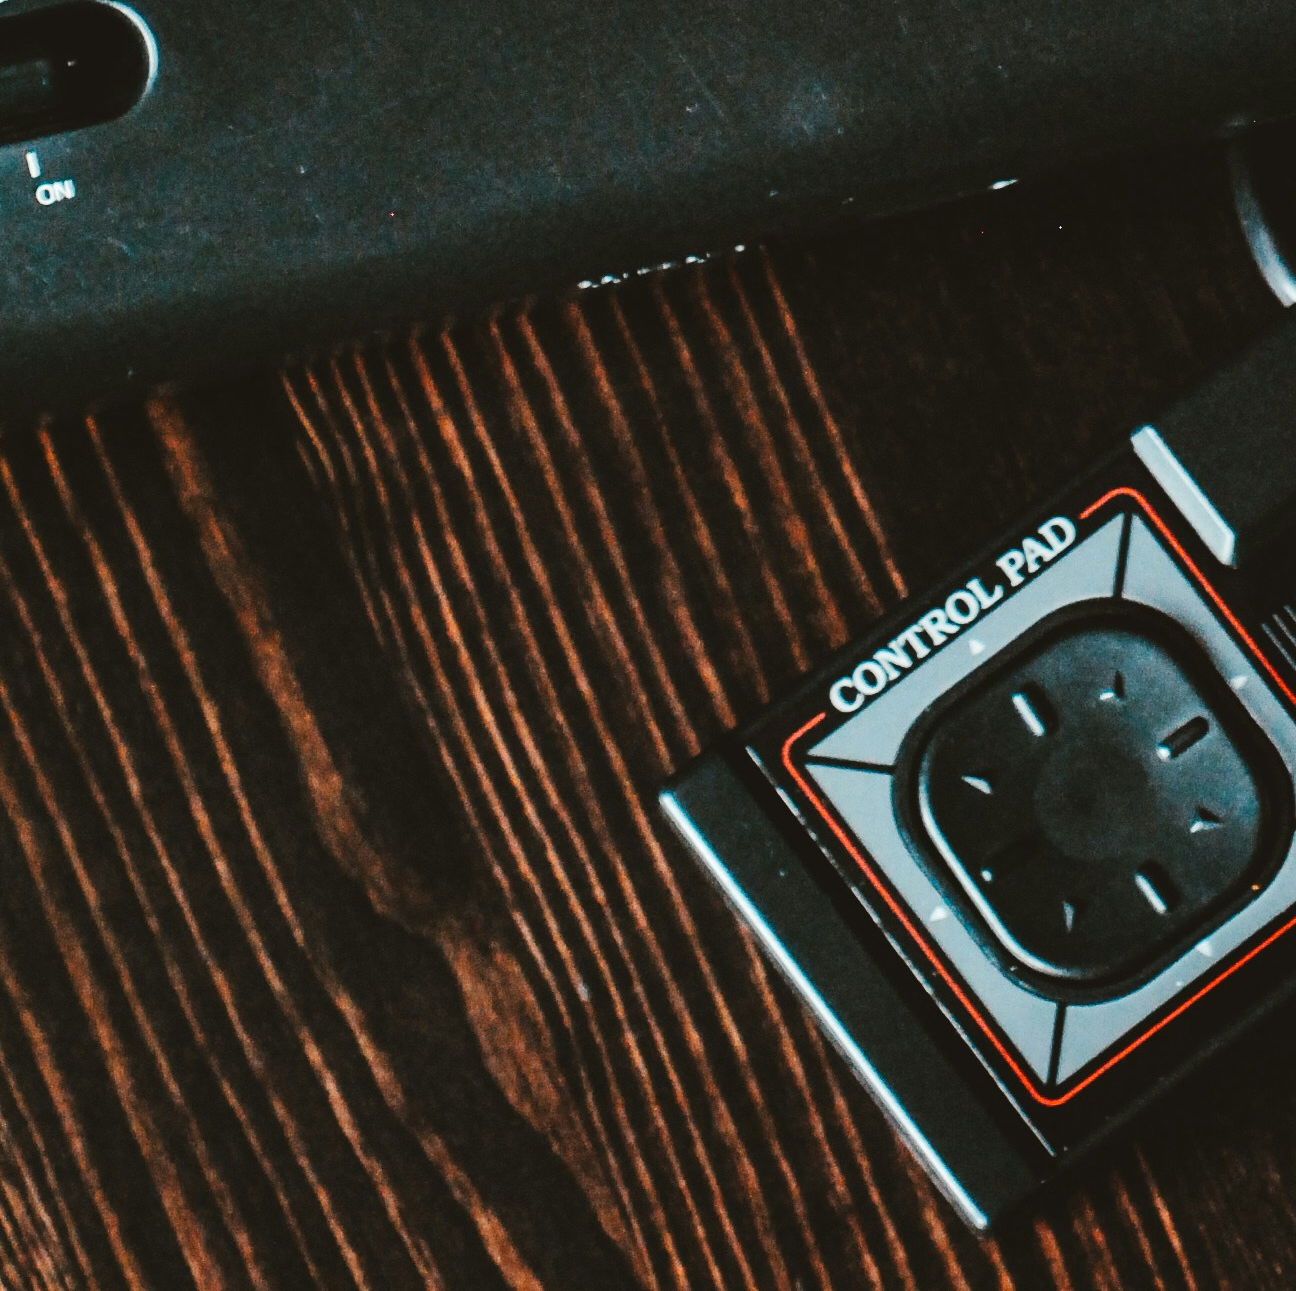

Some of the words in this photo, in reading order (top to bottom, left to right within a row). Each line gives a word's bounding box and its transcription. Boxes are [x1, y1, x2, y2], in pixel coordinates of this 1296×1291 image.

[35, 179, 77, 207] ON
[829, 577, 1004, 714] CONTROL
[995, 516, 1077, 588] PAD
